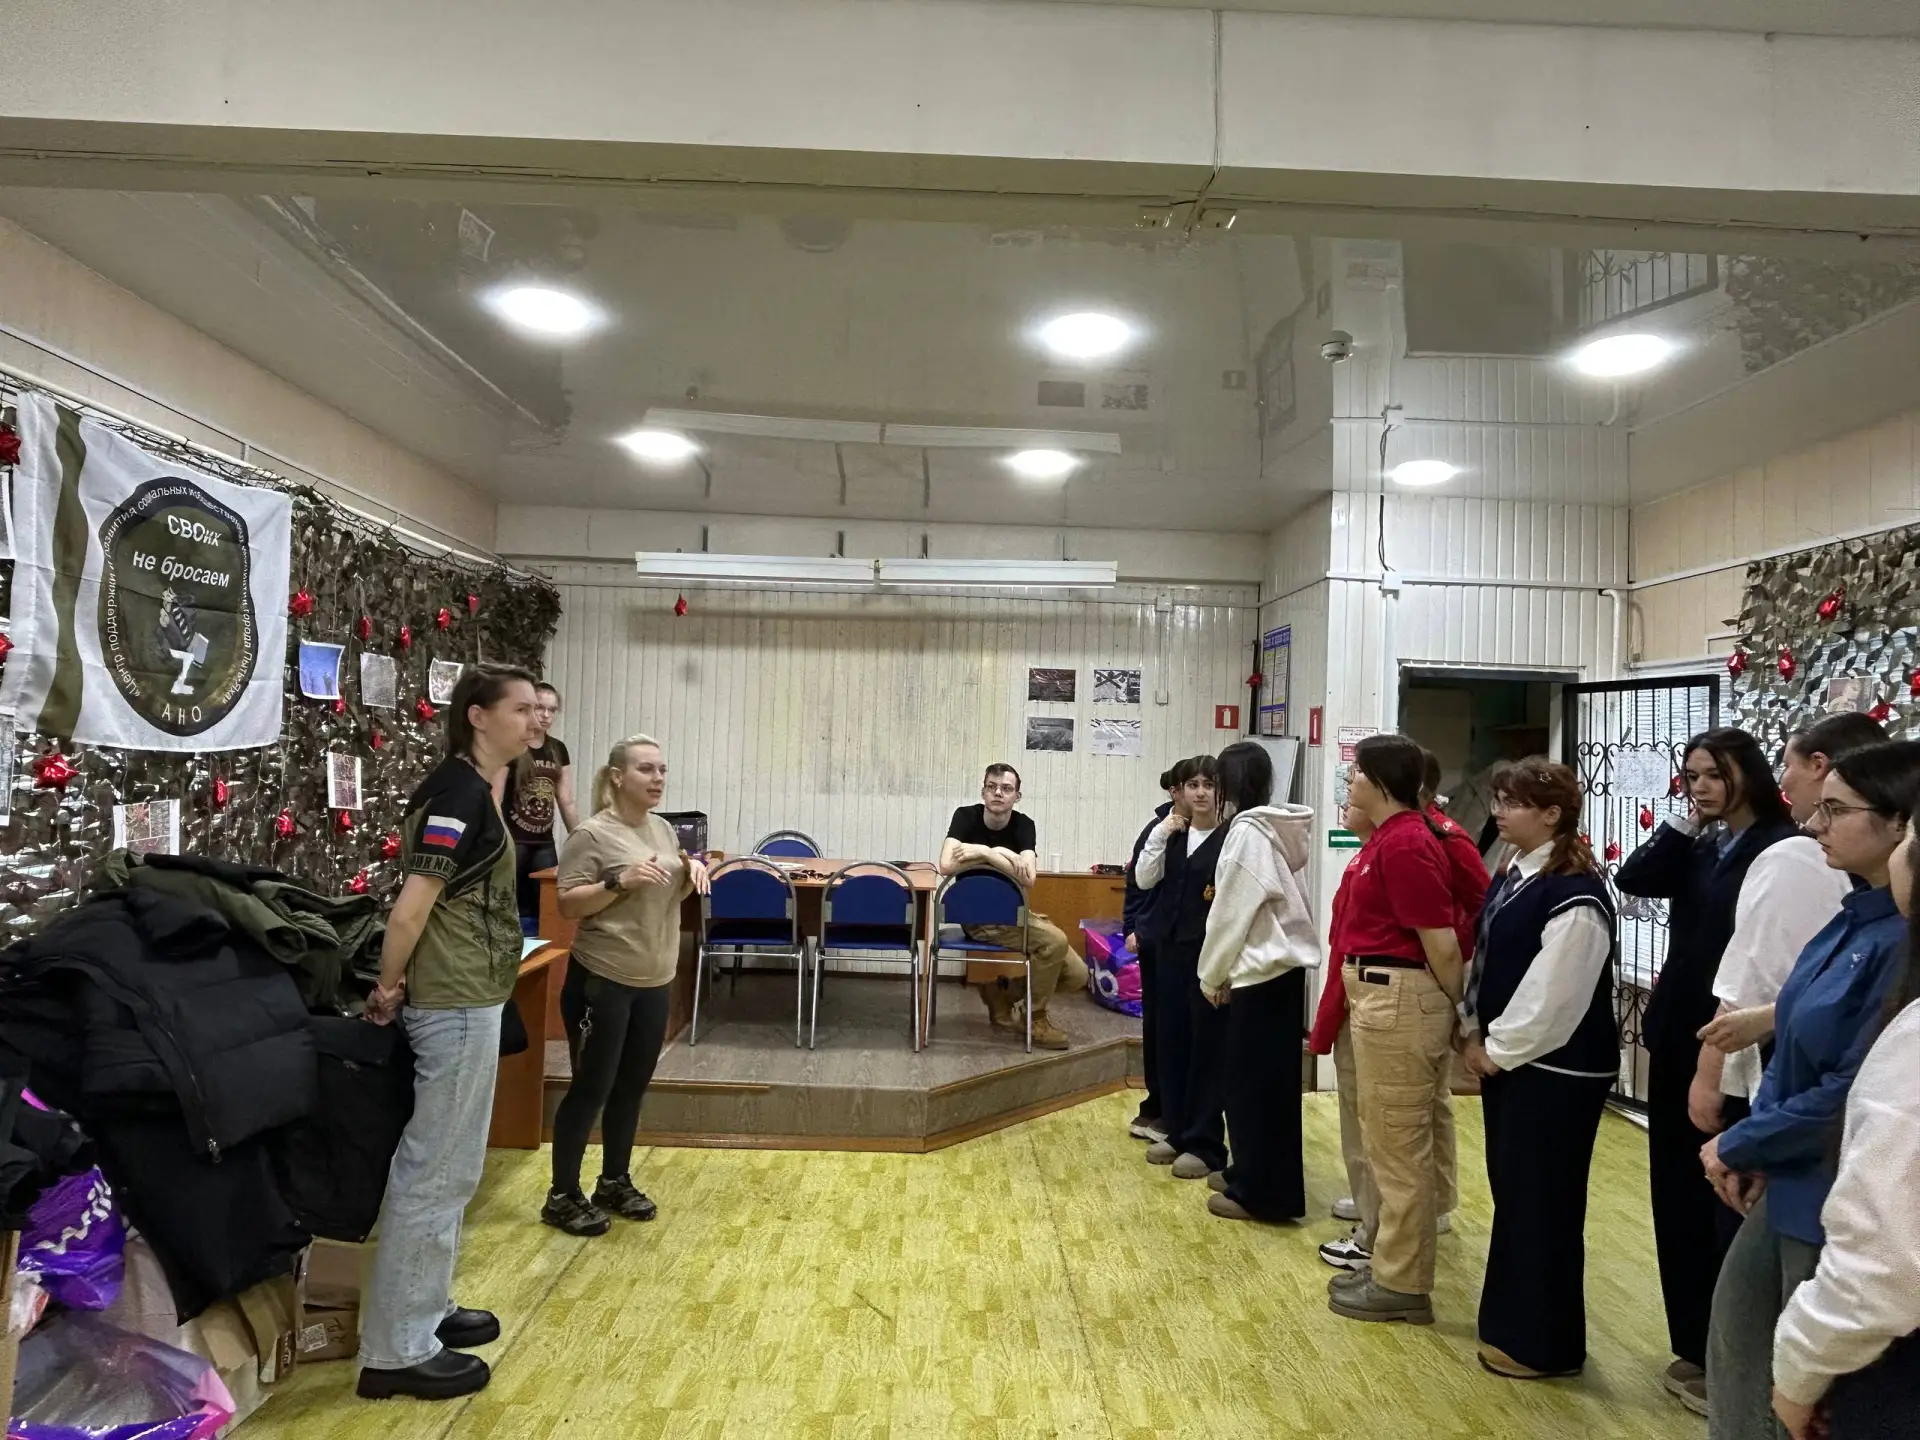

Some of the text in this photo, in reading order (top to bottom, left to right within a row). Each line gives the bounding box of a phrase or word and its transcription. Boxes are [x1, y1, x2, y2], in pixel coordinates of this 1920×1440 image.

[167, 514, 222, 547] СВОих
[132, 551, 156, 571] не
[160, 556, 230, 588] бросаем
[107, 572, 119, 652] поддержки
[114, 654, 140, 697] «Центр
[161, 703, 202, 725] АНО
